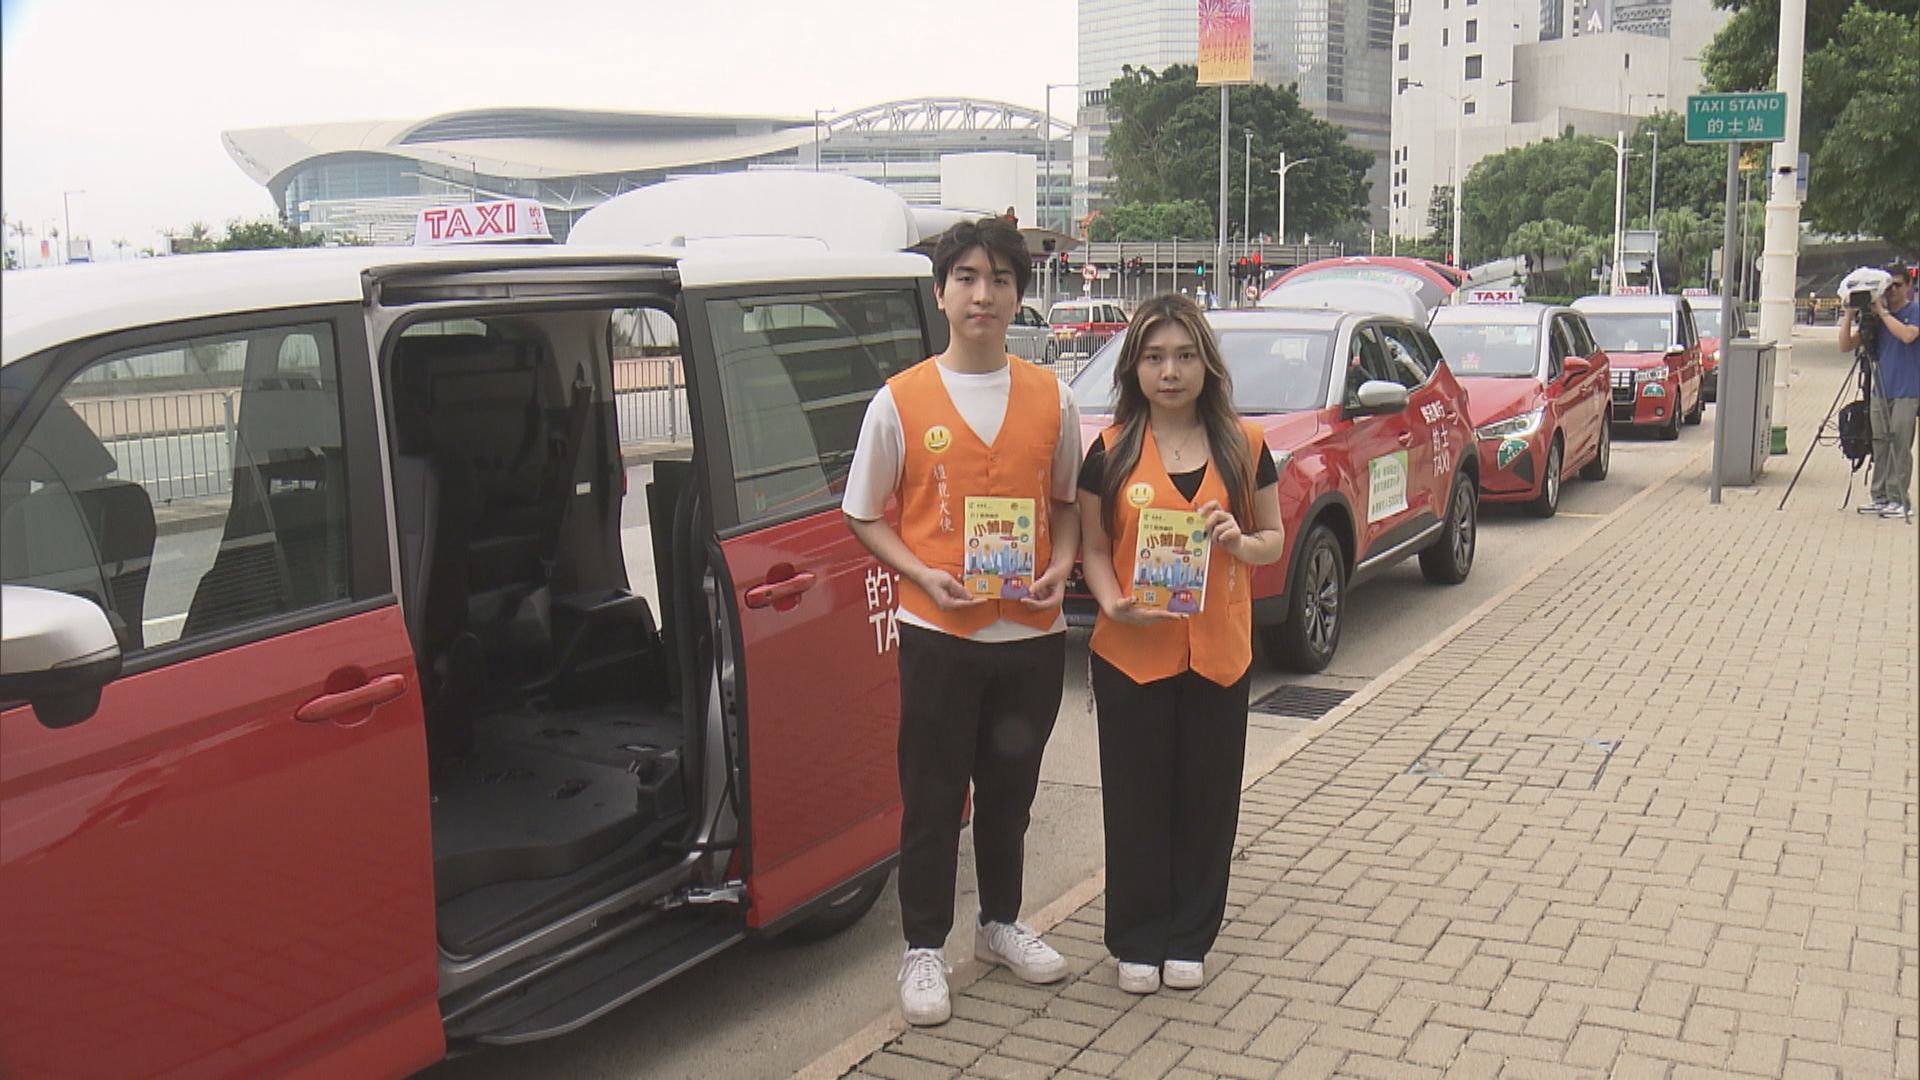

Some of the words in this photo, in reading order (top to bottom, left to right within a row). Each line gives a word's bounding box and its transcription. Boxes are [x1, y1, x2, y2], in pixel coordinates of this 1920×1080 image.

[1693, 99, 1724, 113] TAXI
[1729, 97, 1780, 112] STAND
[1707, 116, 1764, 134] 的士站
[424, 203, 516, 239] TAXI
[1474, 291, 1514, 301] TAXI
[1433, 449, 1451, 478] TAXI
[865, 566, 900, 611] 的
[869, 608, 900, 654] TA
